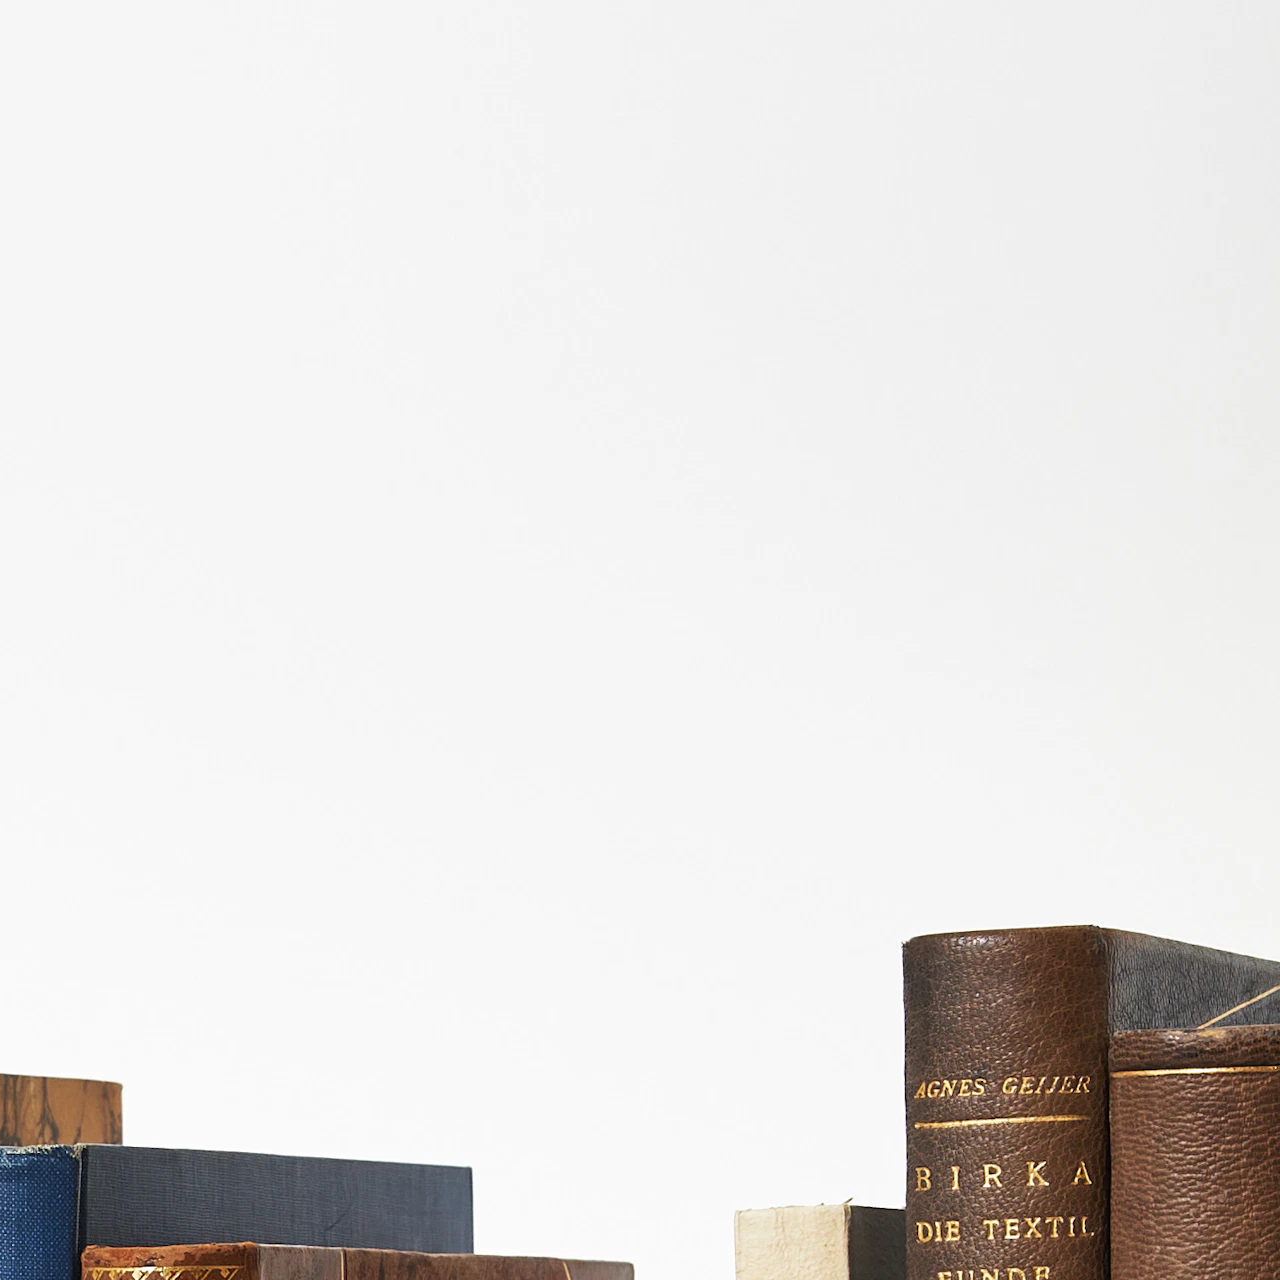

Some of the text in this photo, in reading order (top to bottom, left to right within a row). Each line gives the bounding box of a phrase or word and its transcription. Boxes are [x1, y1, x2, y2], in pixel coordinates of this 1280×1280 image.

[914, 1075, 1091, 1098] AGNES GEIJER
[915, 1161, 1093, 1191] BIRKA
[916, 1220, 961, 1243] DIE
